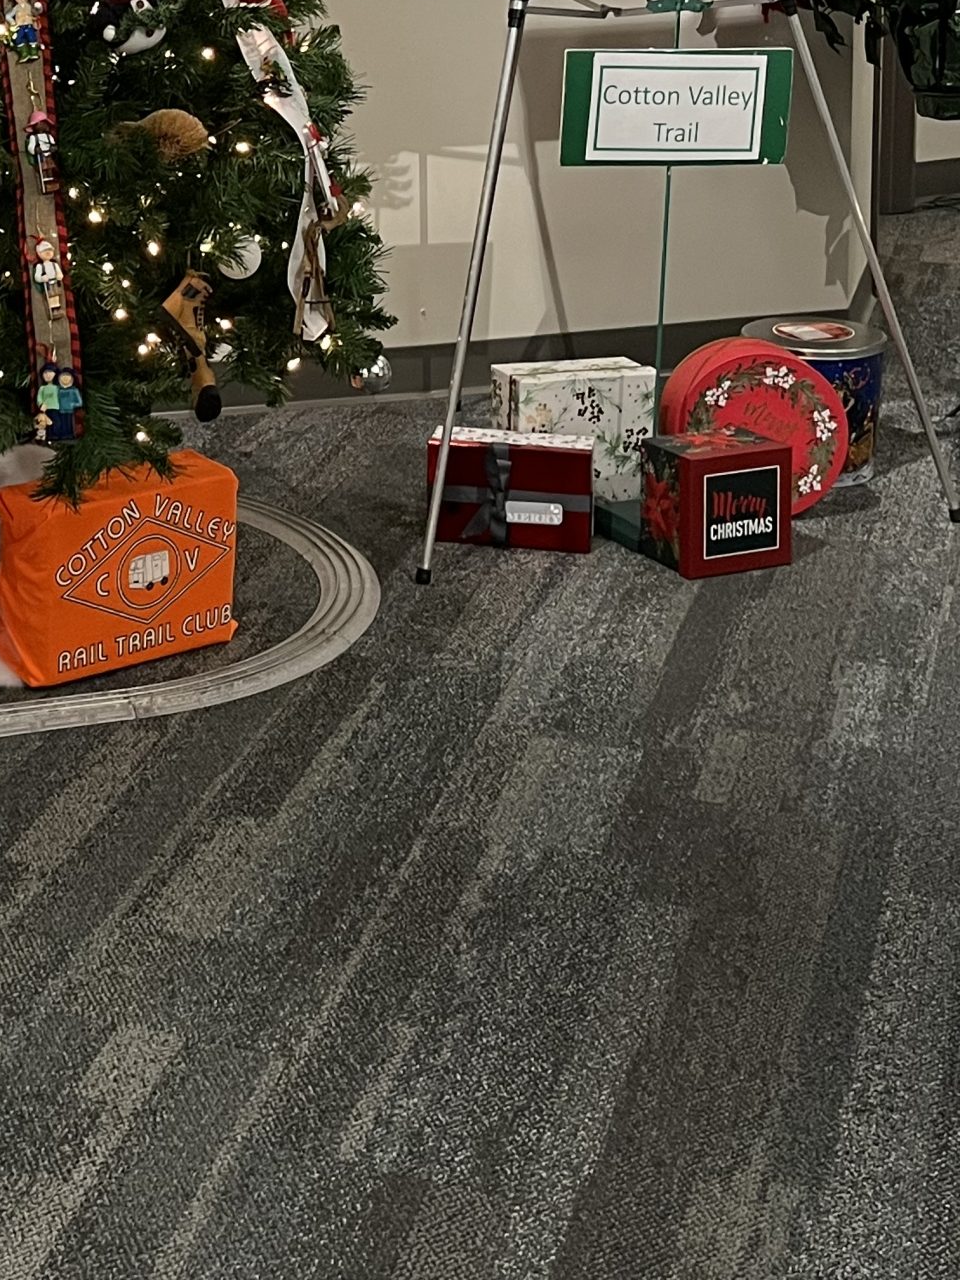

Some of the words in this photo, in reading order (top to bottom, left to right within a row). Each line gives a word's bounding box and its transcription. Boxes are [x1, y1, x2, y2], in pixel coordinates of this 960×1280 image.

[603, 84, 680, 106] Cotton
[689, 85, 753, 110] Valley
[653, 121, 699, 143] Trail
[55, 499, 141, 587] COTTON
[154, 494, 235, 542] VALLEY
[710, 516, 773, 540] CHRISTMAS
[96, 572, 110, 596] C
[184, 546, 200, 571] V
[58, 641, 108, 672] RAIL
[116, 623, 176, 657] TRAIL
[182, 603, 232, 636] CLUB
